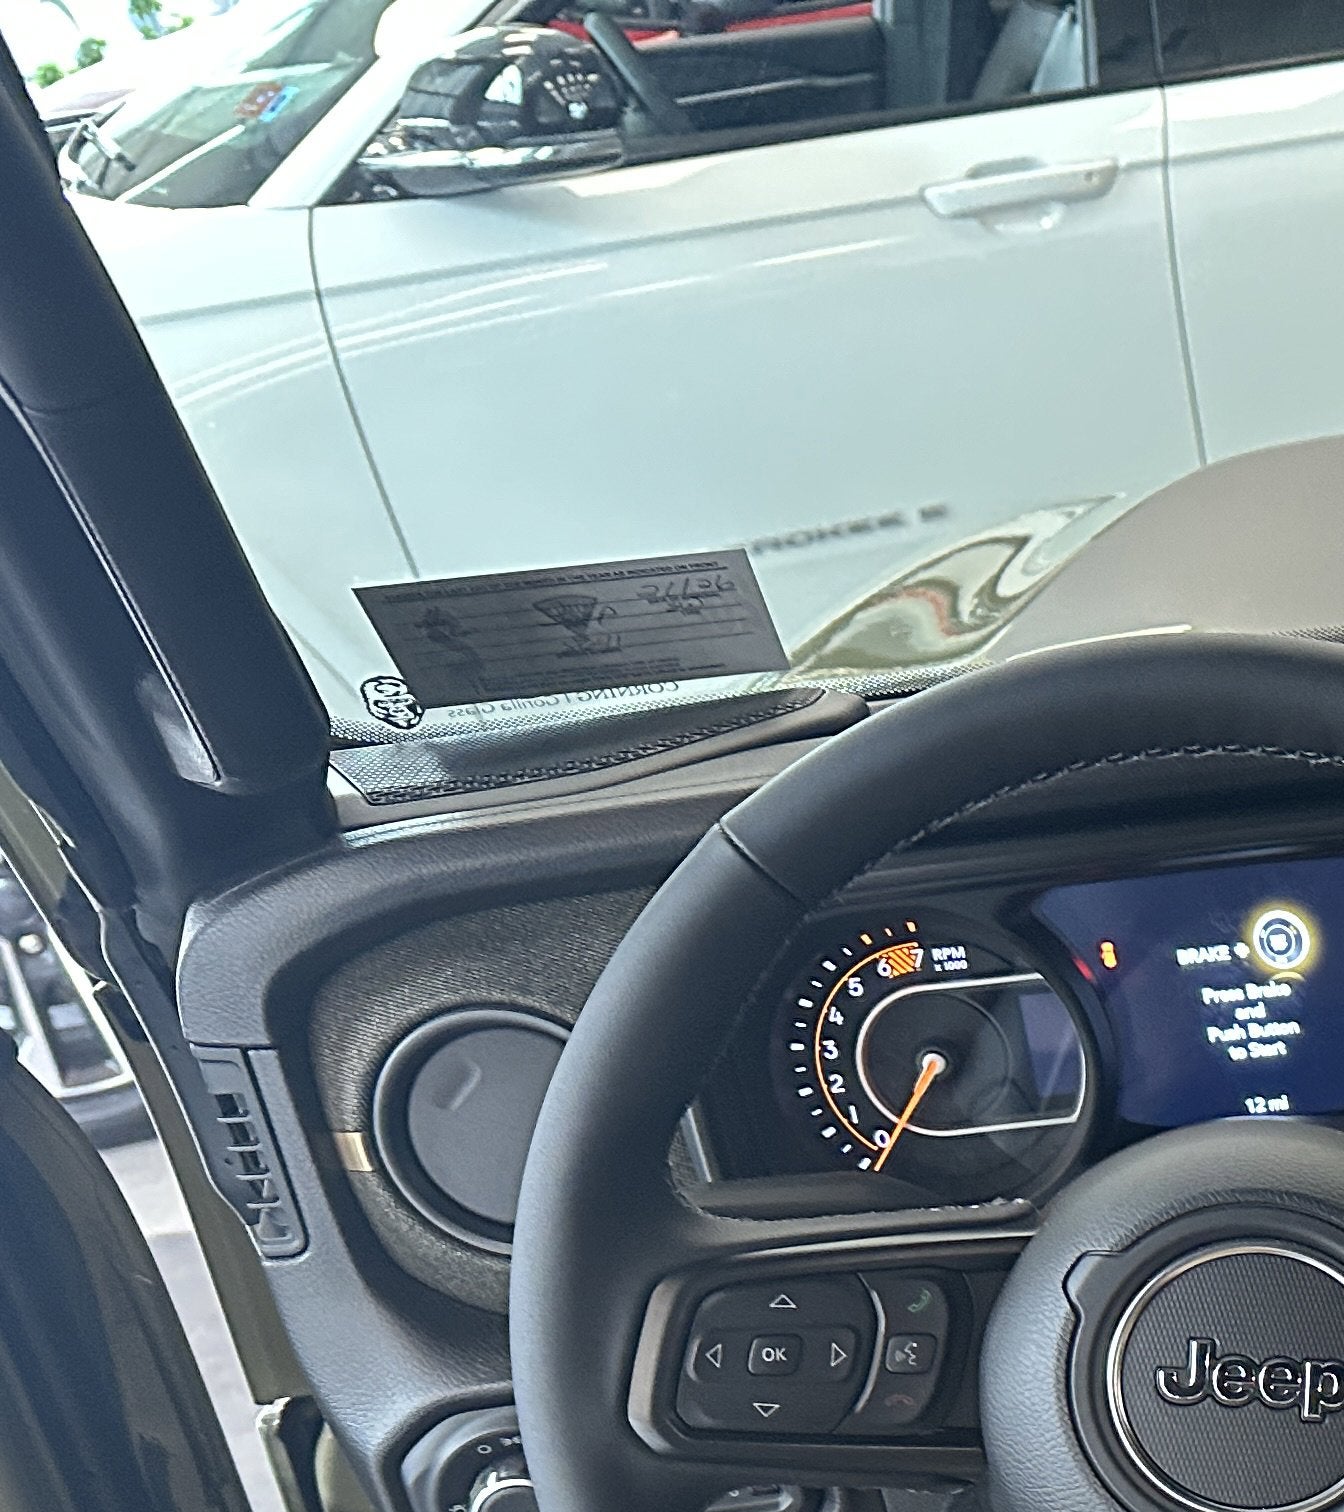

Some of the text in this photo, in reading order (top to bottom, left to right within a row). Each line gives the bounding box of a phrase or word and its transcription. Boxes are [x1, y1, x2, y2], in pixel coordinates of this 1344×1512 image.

[910, 948, 924, 969] 7
[931, 946, 967, 962] RPM
[1176, 944, 1232, 967] BRAKE
[876, 957, 892, 978] 6
[944, 959, 968, 972] 1000
[848, 977, 864, 997] 5
[1201, 981, 1292, 1005] Press Brake
[828, 1006, 844, 1026] 4
[1234, 1002, 1267, 1021] and
[1207, 1021, 1300, 1044] Push Button
[822, 1039, 839, 1060] 3
[1227, 1040, 1288, 1062] to Start
[829, 1074, 845, 1094] 2
[1268, 1094, 1291, 1112] mi
[849, 1104, 859, 1125] 1
[873, 1129, 892, 1149] 0
[761, 1346, 788, 1363] OK
